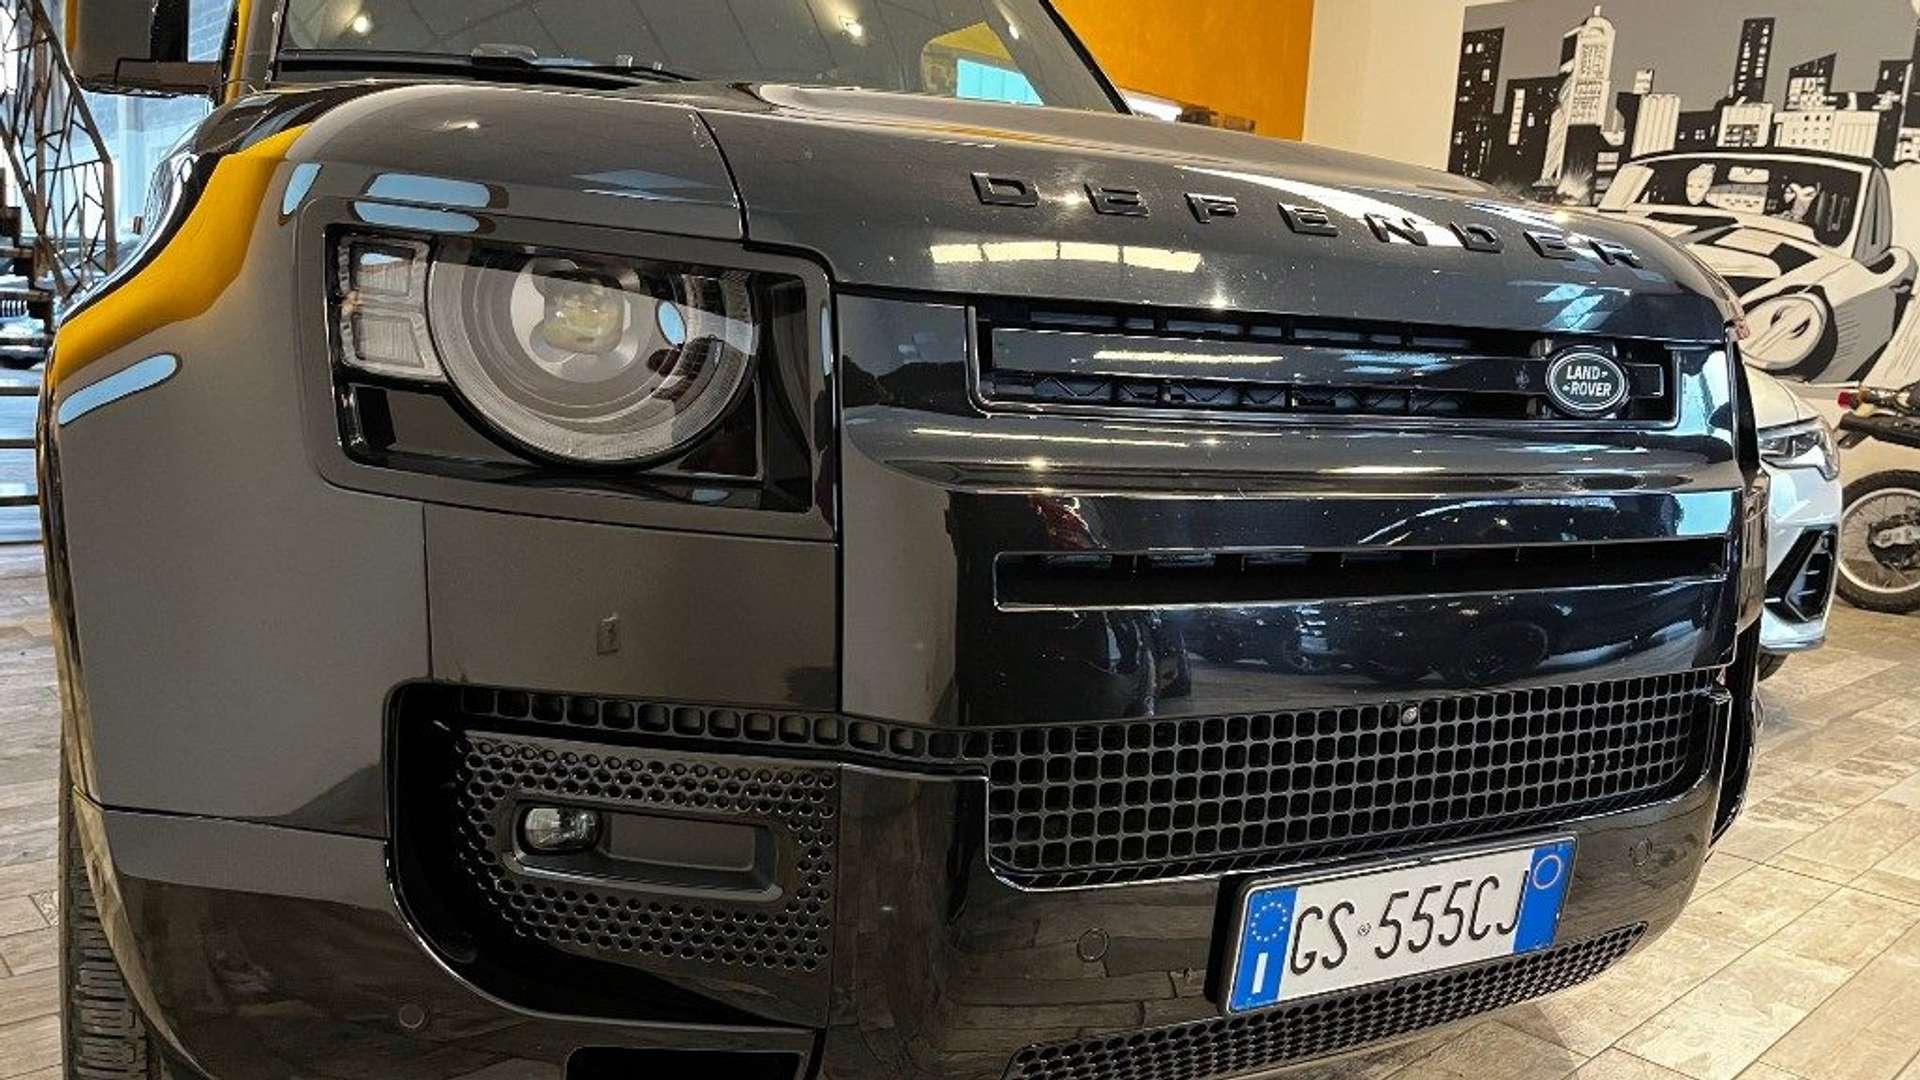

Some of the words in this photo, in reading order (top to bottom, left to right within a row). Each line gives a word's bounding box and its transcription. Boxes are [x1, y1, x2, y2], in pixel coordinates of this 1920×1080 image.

[970, 171, 1642, 268] DEFENDER
[1290, 901, 1355, 975] GS
[1374, 870, 1529, 960] 555CJ
